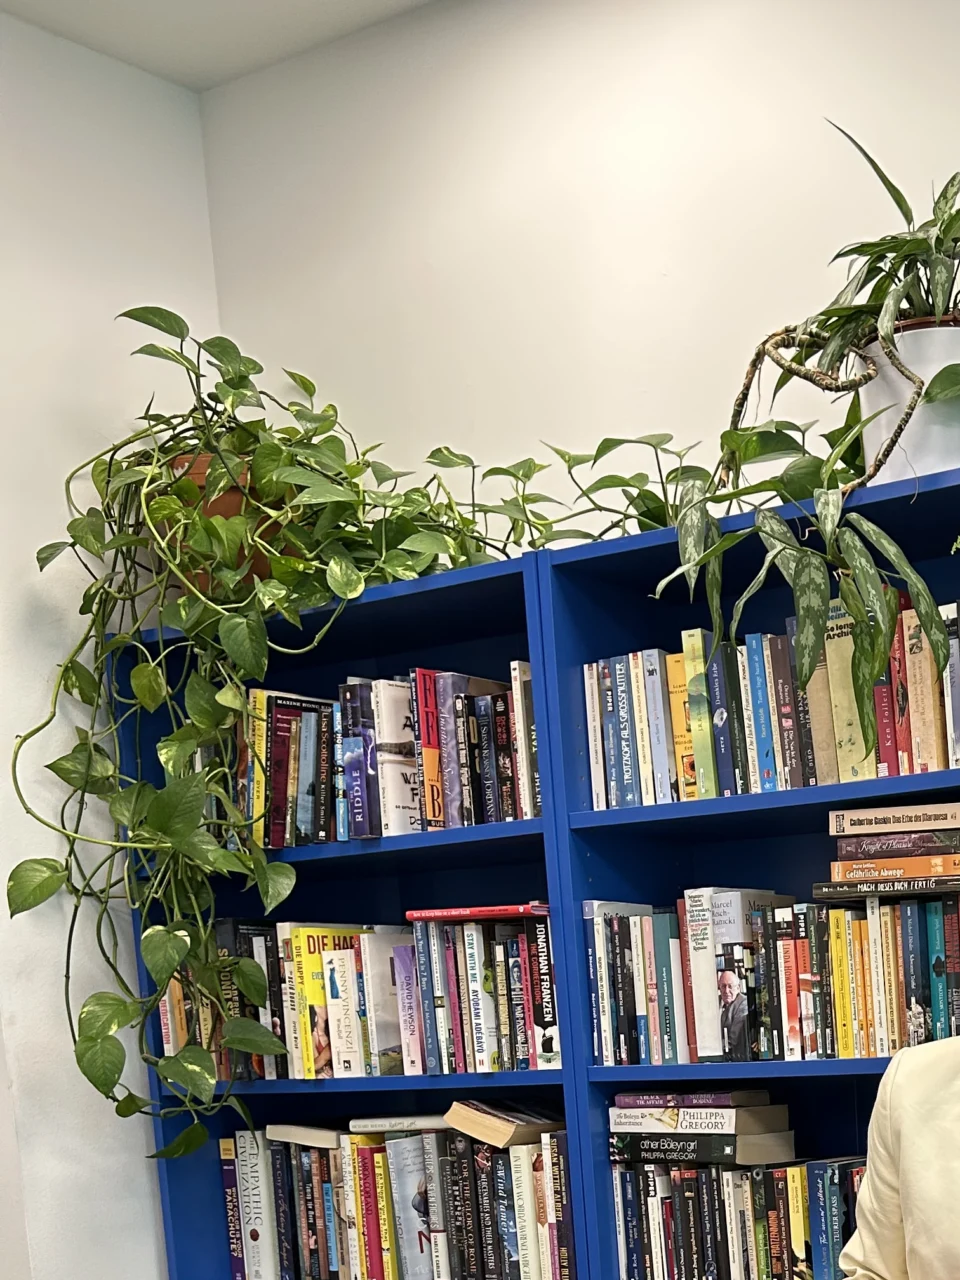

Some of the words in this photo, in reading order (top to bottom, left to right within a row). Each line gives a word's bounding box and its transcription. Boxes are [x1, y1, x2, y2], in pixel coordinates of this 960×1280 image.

[616, 663, 628, 721] GROSSMUTTER
[620, 722, 629, 739] ALS
[621, 740, 632, 785] TROTZKOPF
[355, 769, 364, 823] RIDDLE
[846, 868, 879, 879] Gefährliche
[880, 868, 904, 878] Abwege
[857, 883, 875, 892] MACH
[910, 879, 935, 890] FERTIG
[307, 935, 328, 954] DIE
[296, 961, 304, 985] HAPPY
[338, 957, 348, 994] PENNY
[404, 975, 413, 998] DAVID
[536, 923, 546, 970] JONATHAN
[541, 972, 553, 1022] FRANZEN
[341, 996, 354, 1050] VINCENZI
[405, 1000, 416, 1036] HEWSON
[680, 1120, 726, 1130] GREGORY
[682, 1111, 725, 1120] PHILIPPA
[640, 1140, 659, 1149] other
[660, 1138, 686, 1151] Boleyn
[641, 1152, 664, 1160] PHILIPPA
[665, 1152, 697, 1160] GREGORY
[238, 1135, 252, 1226] CIVILIZATION
[250, 1152, 263, 1227] EMPATHIC
[648, 1174, 656, 1197] PIPER
[226, 1188, 237, 1257] PARACHUTE?
[769, 1211, 778, 1257] FRATZENMOND
